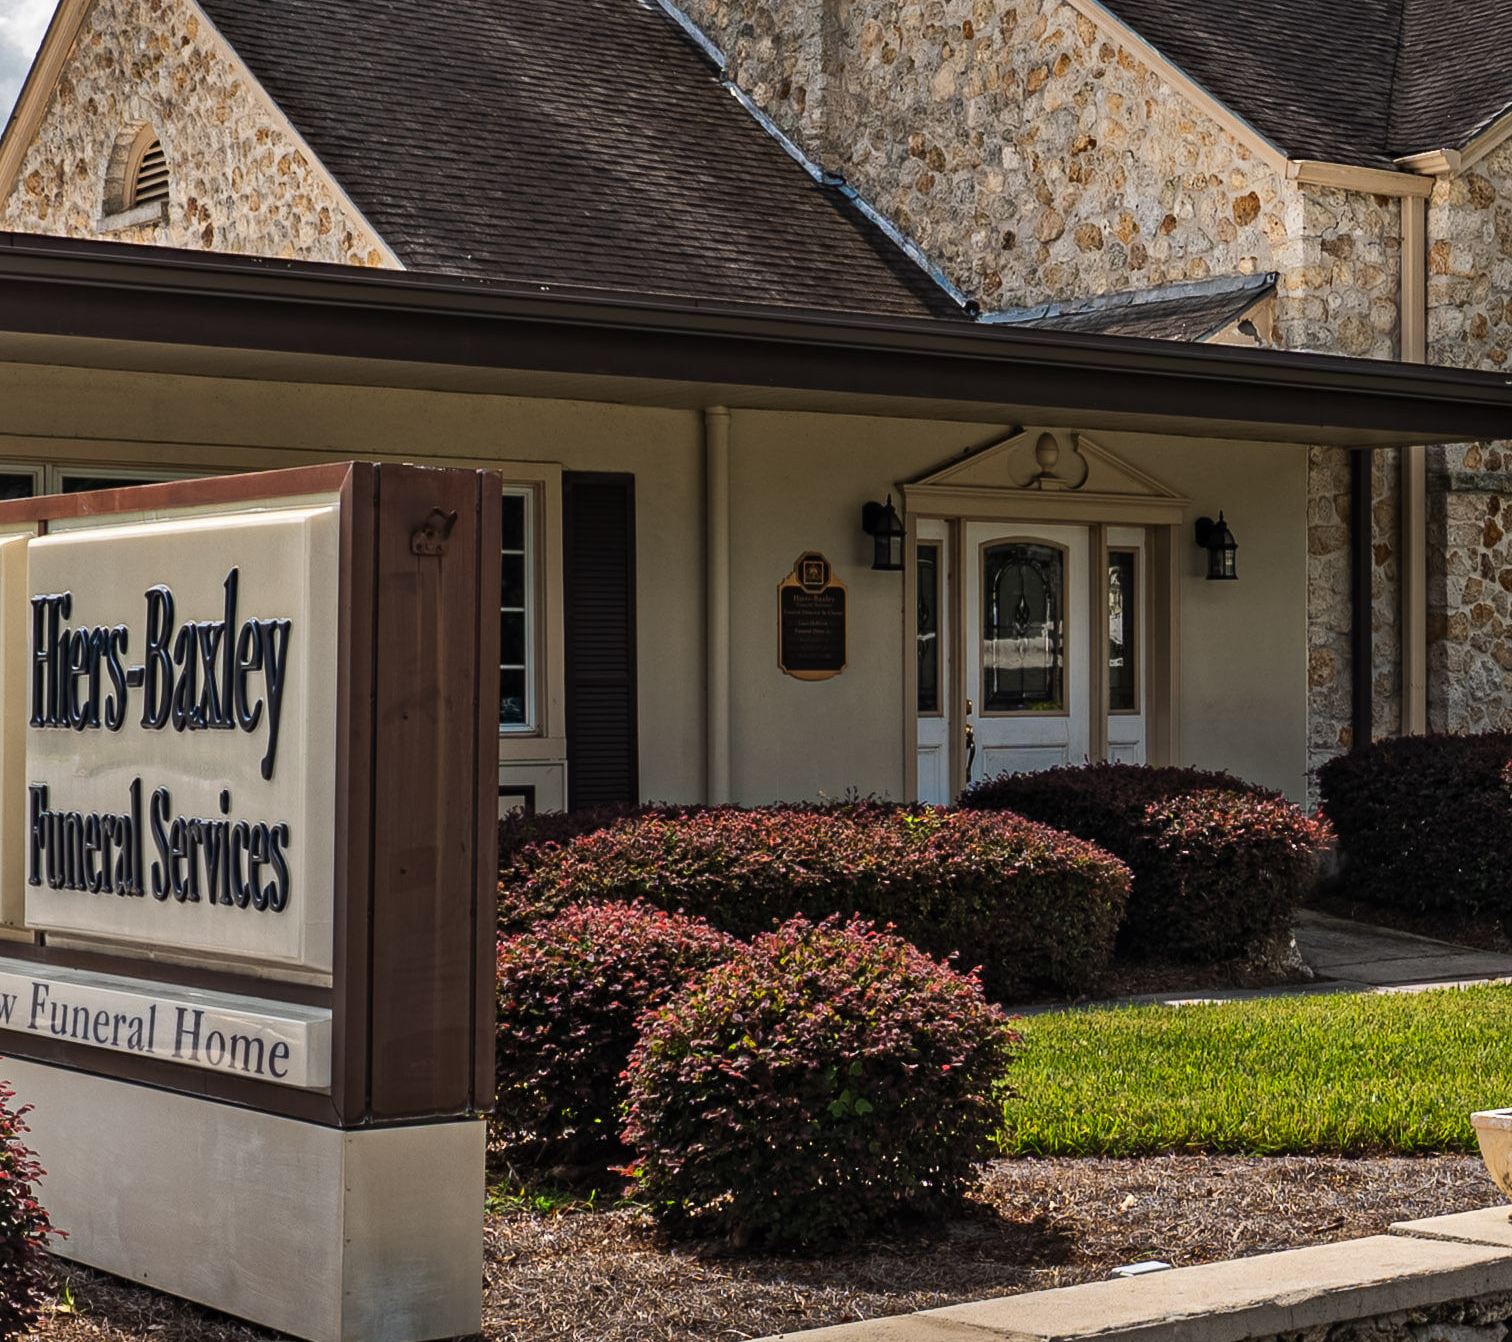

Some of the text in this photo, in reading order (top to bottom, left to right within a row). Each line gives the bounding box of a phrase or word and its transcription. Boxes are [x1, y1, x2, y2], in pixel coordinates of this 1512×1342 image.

[28, 566, 292, 780] Hiers-Baxley
[27, 776, 290, 913] Funeral Services
[29, 982, 156, 1055] Funeral
[173, 1006, 290, 1079] Home
